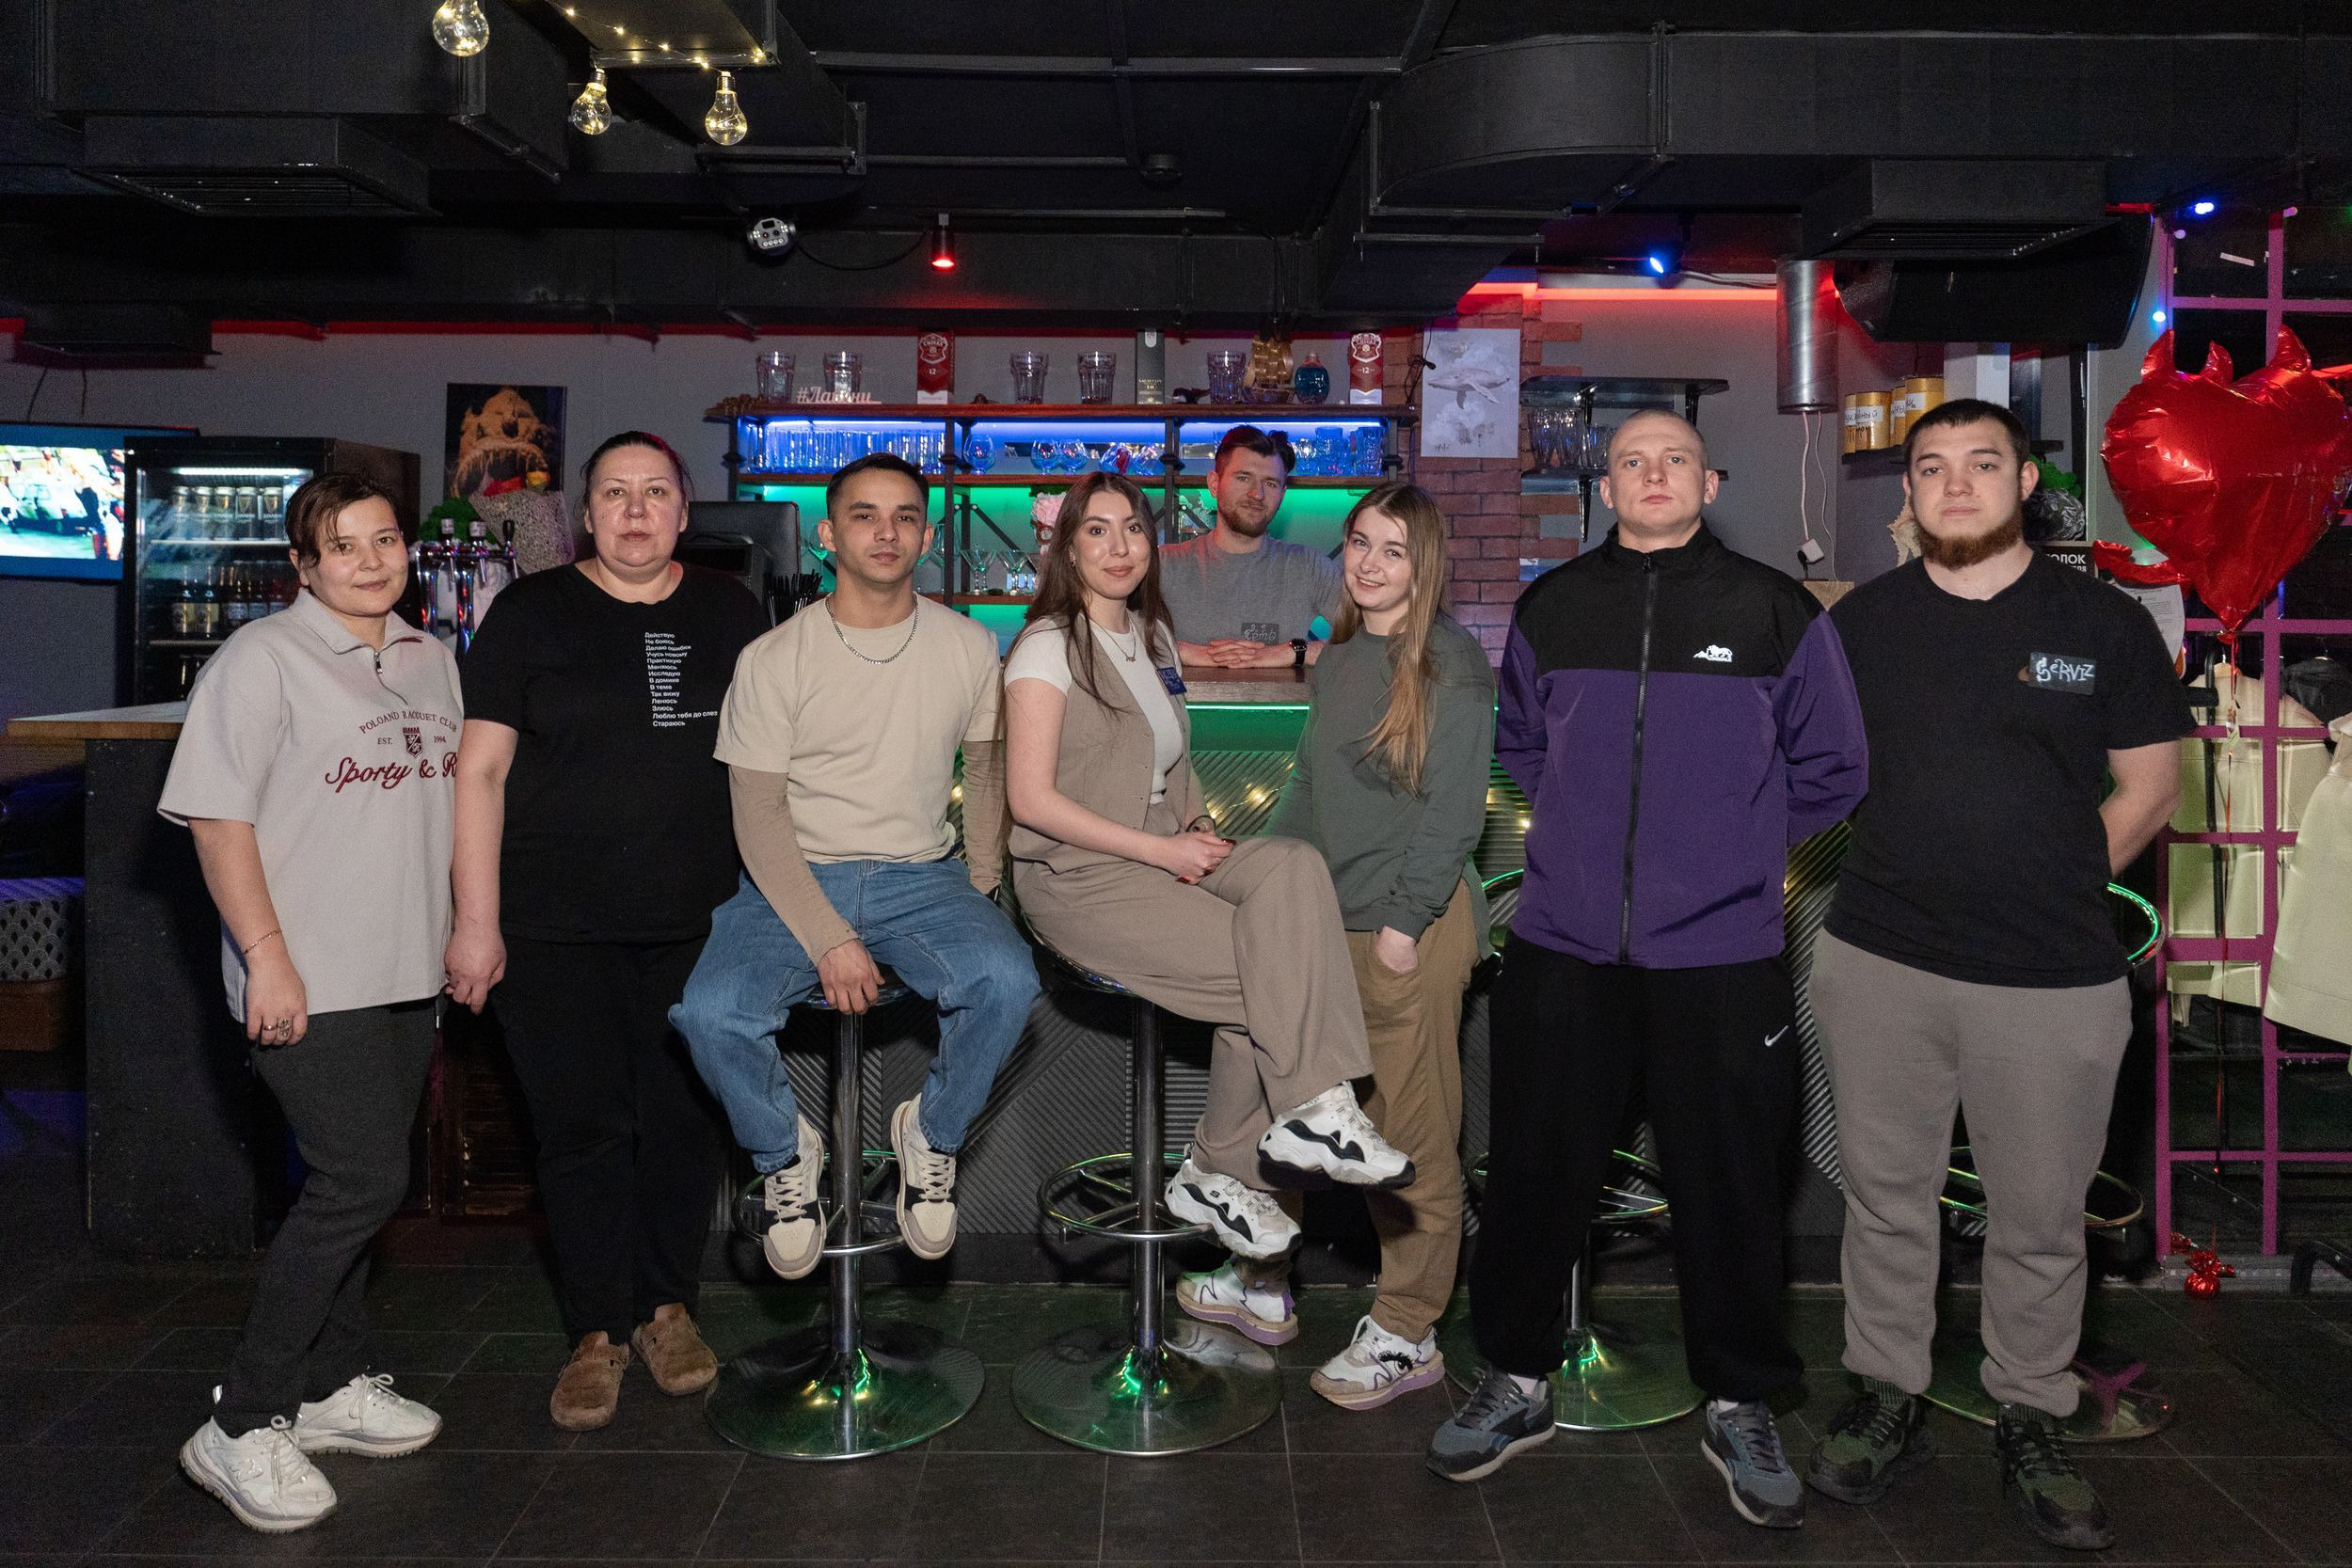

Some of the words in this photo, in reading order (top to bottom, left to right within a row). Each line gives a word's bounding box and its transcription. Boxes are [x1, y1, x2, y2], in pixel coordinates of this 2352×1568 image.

[439, 716, 457, 733] CLUB
[325, 756, 412, 793] Sporty
[419, 759, 437, 778] &
[442, 752, 457, 778] R
